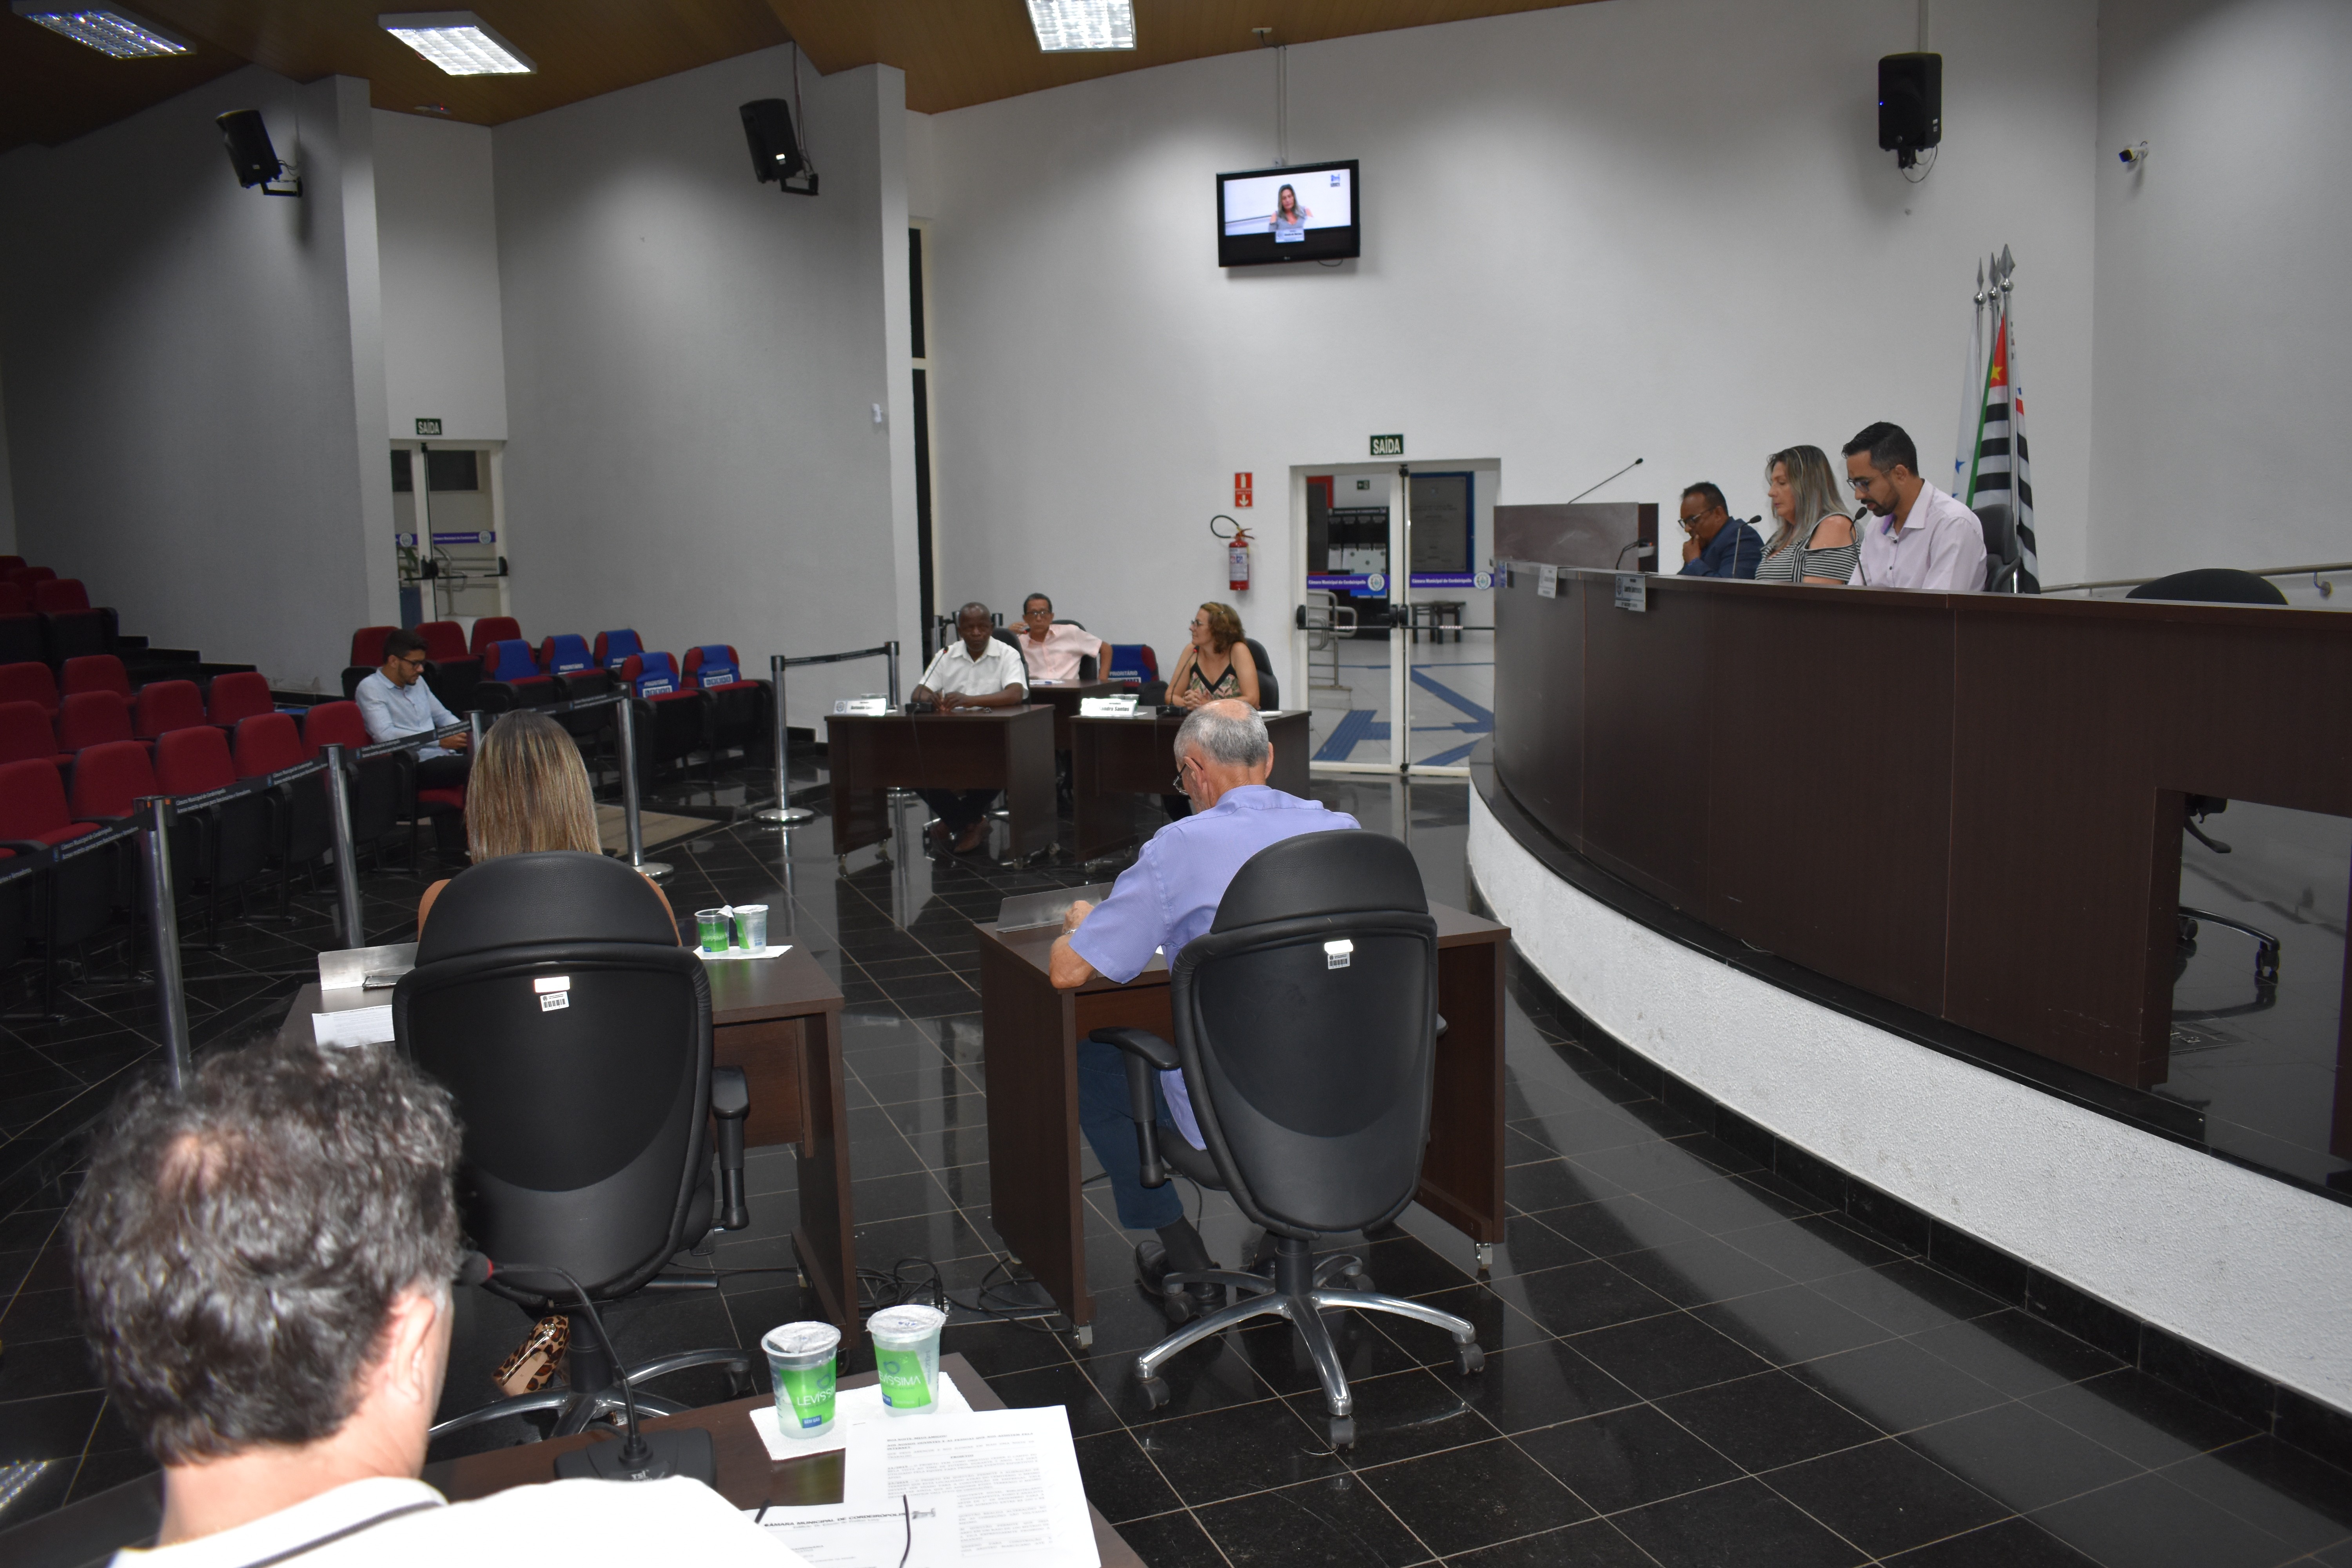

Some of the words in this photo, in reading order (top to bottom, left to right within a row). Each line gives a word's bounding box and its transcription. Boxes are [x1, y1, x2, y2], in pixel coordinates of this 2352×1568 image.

[417, 419, 440, 434] SAÍDA
[1373, 436, 1401, 454] SAÍDA
[176, 797, 188, 806] Câmara
[188, 793, 202, 803] Municipal
[207, 786, 225, 797] Cordeirópolis
[187, 803, 199, 811] restrito
[199, 800, 209, 808] apenas
[216, 793, 233, 803] funcionários
[236, 788, 251, 797] Vereadores
[61, 840, 73, 851] Câmara
[74, 835, 89, 846] Municipal
[93, 825, 113, 838] Cordeirópolis
[63, 850, 73, 860] Acesso
[73, 846, 85, 856] restrito
[85, 842, 96, 851] apenas
[123, 825, 138, 837] Vereadores
[878, 1371, 921, 1386] EVÍSSIMA
